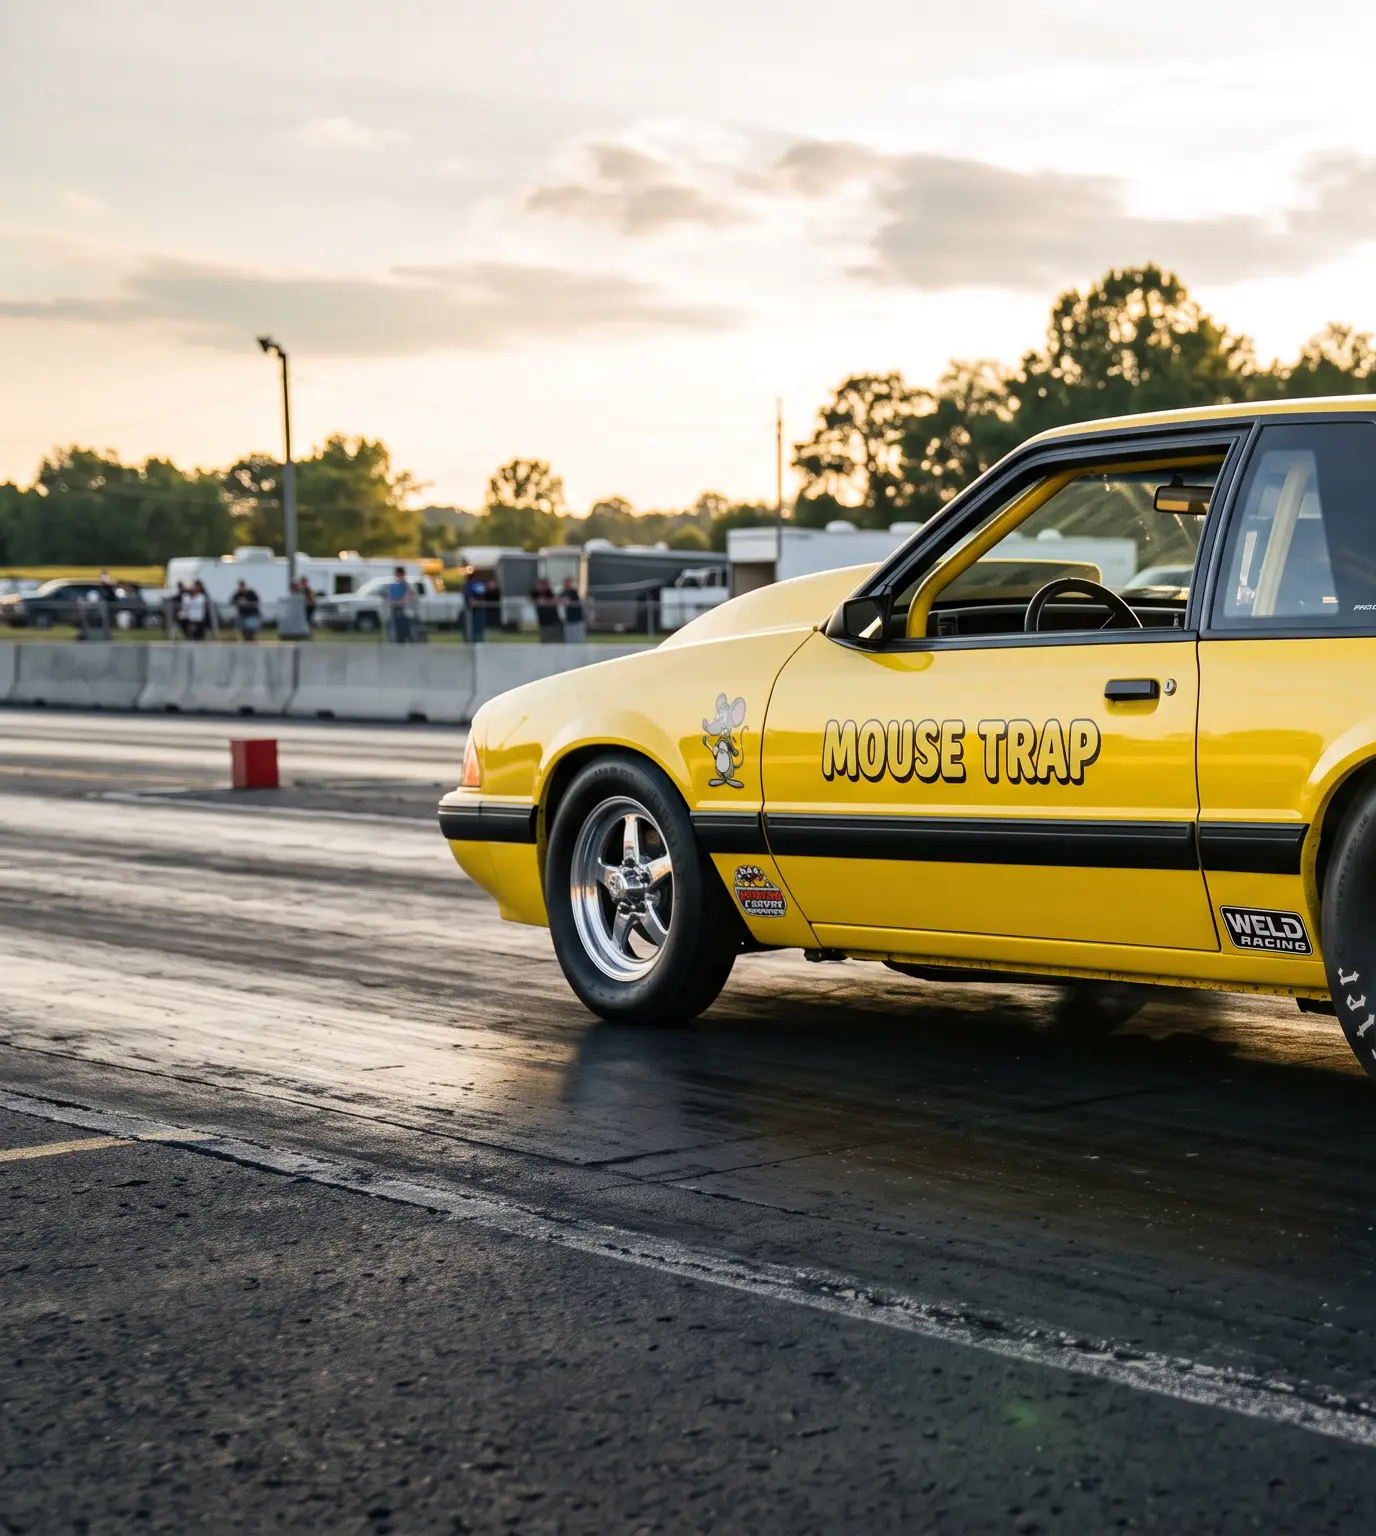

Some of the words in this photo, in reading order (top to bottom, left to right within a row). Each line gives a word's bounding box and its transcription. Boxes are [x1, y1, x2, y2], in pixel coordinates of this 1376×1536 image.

[822, 719, 967, 784] MOUSE
[977, 718, 1101, 786] TRAP
[1225, 912, 1304, 939] WELD
[1241, 936, 1307, 951] RACING
